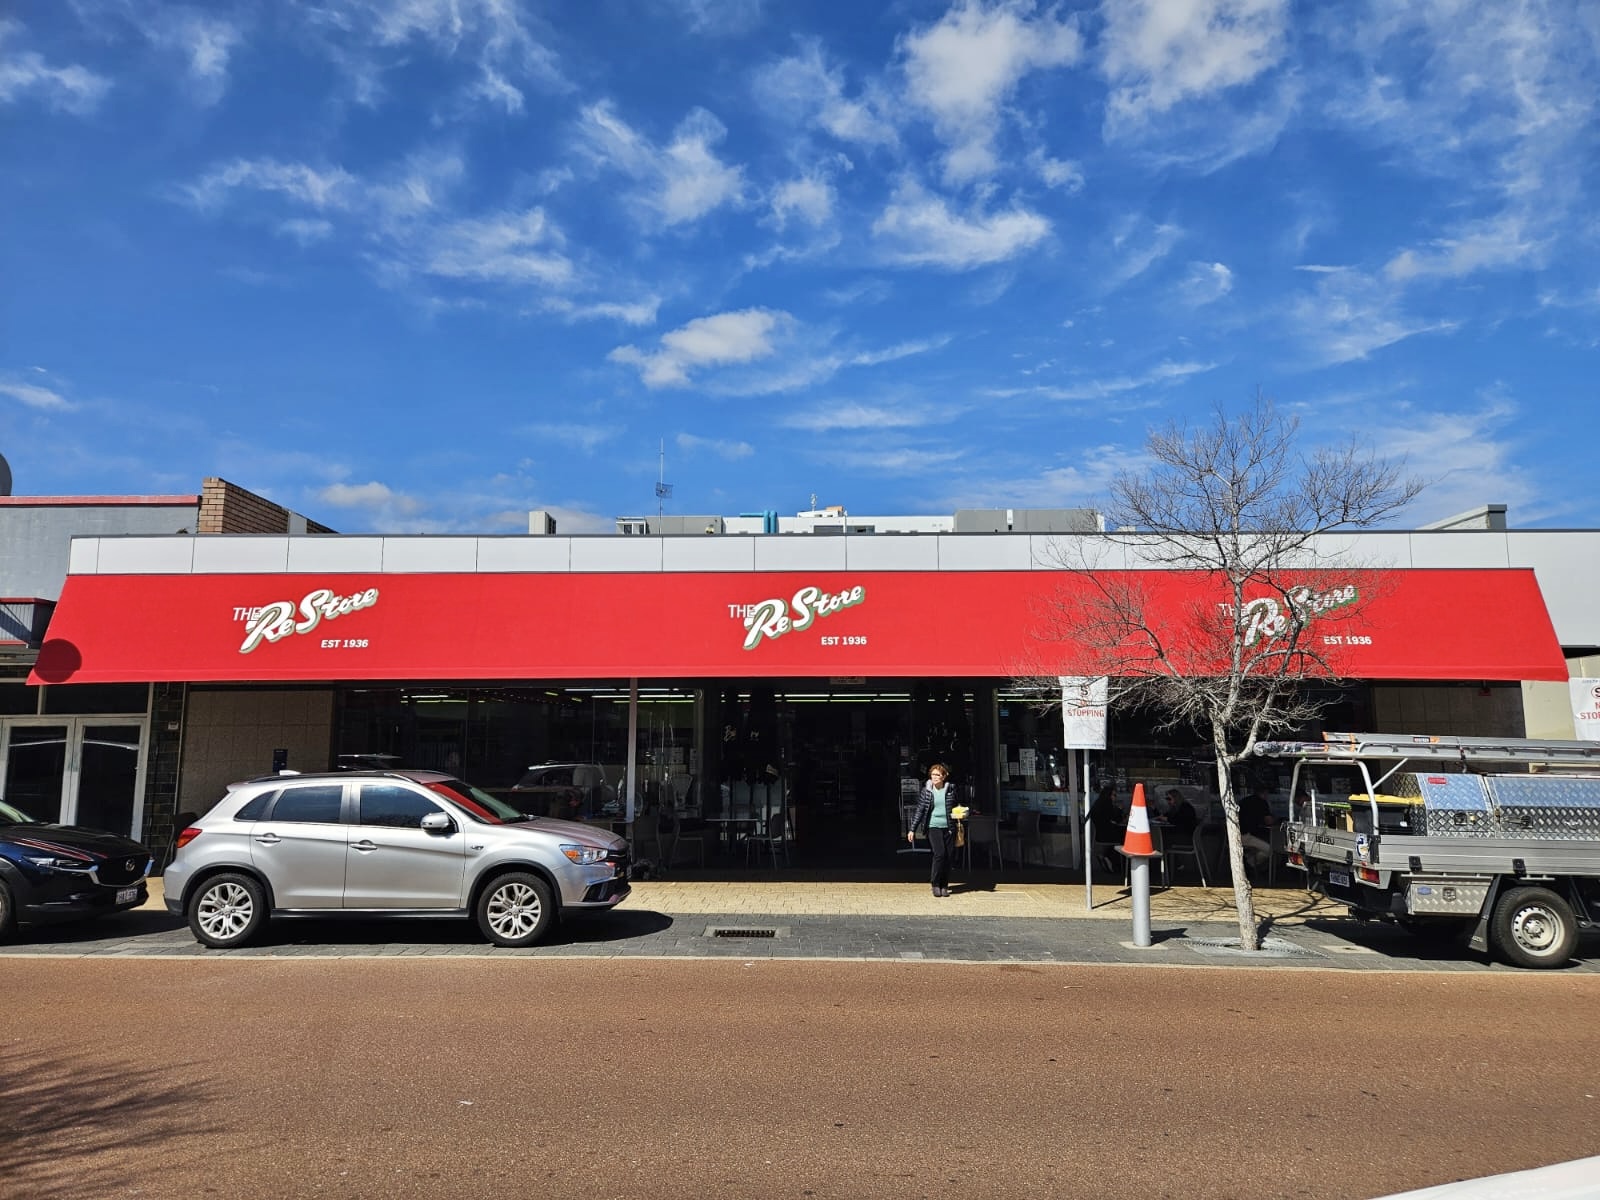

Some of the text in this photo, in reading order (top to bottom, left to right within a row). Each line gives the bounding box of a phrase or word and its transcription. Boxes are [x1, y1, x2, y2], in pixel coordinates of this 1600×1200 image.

[233, 607, 262, 621] THE
[728, 604, 756, 618] THE
[320, 639, 369, 649] EST 1936
[821, 636, 867, 646] EST 1936
[1323, 636, 1372, 645] EST 1936
[1067, 708, 1105, 718] STOPPING
